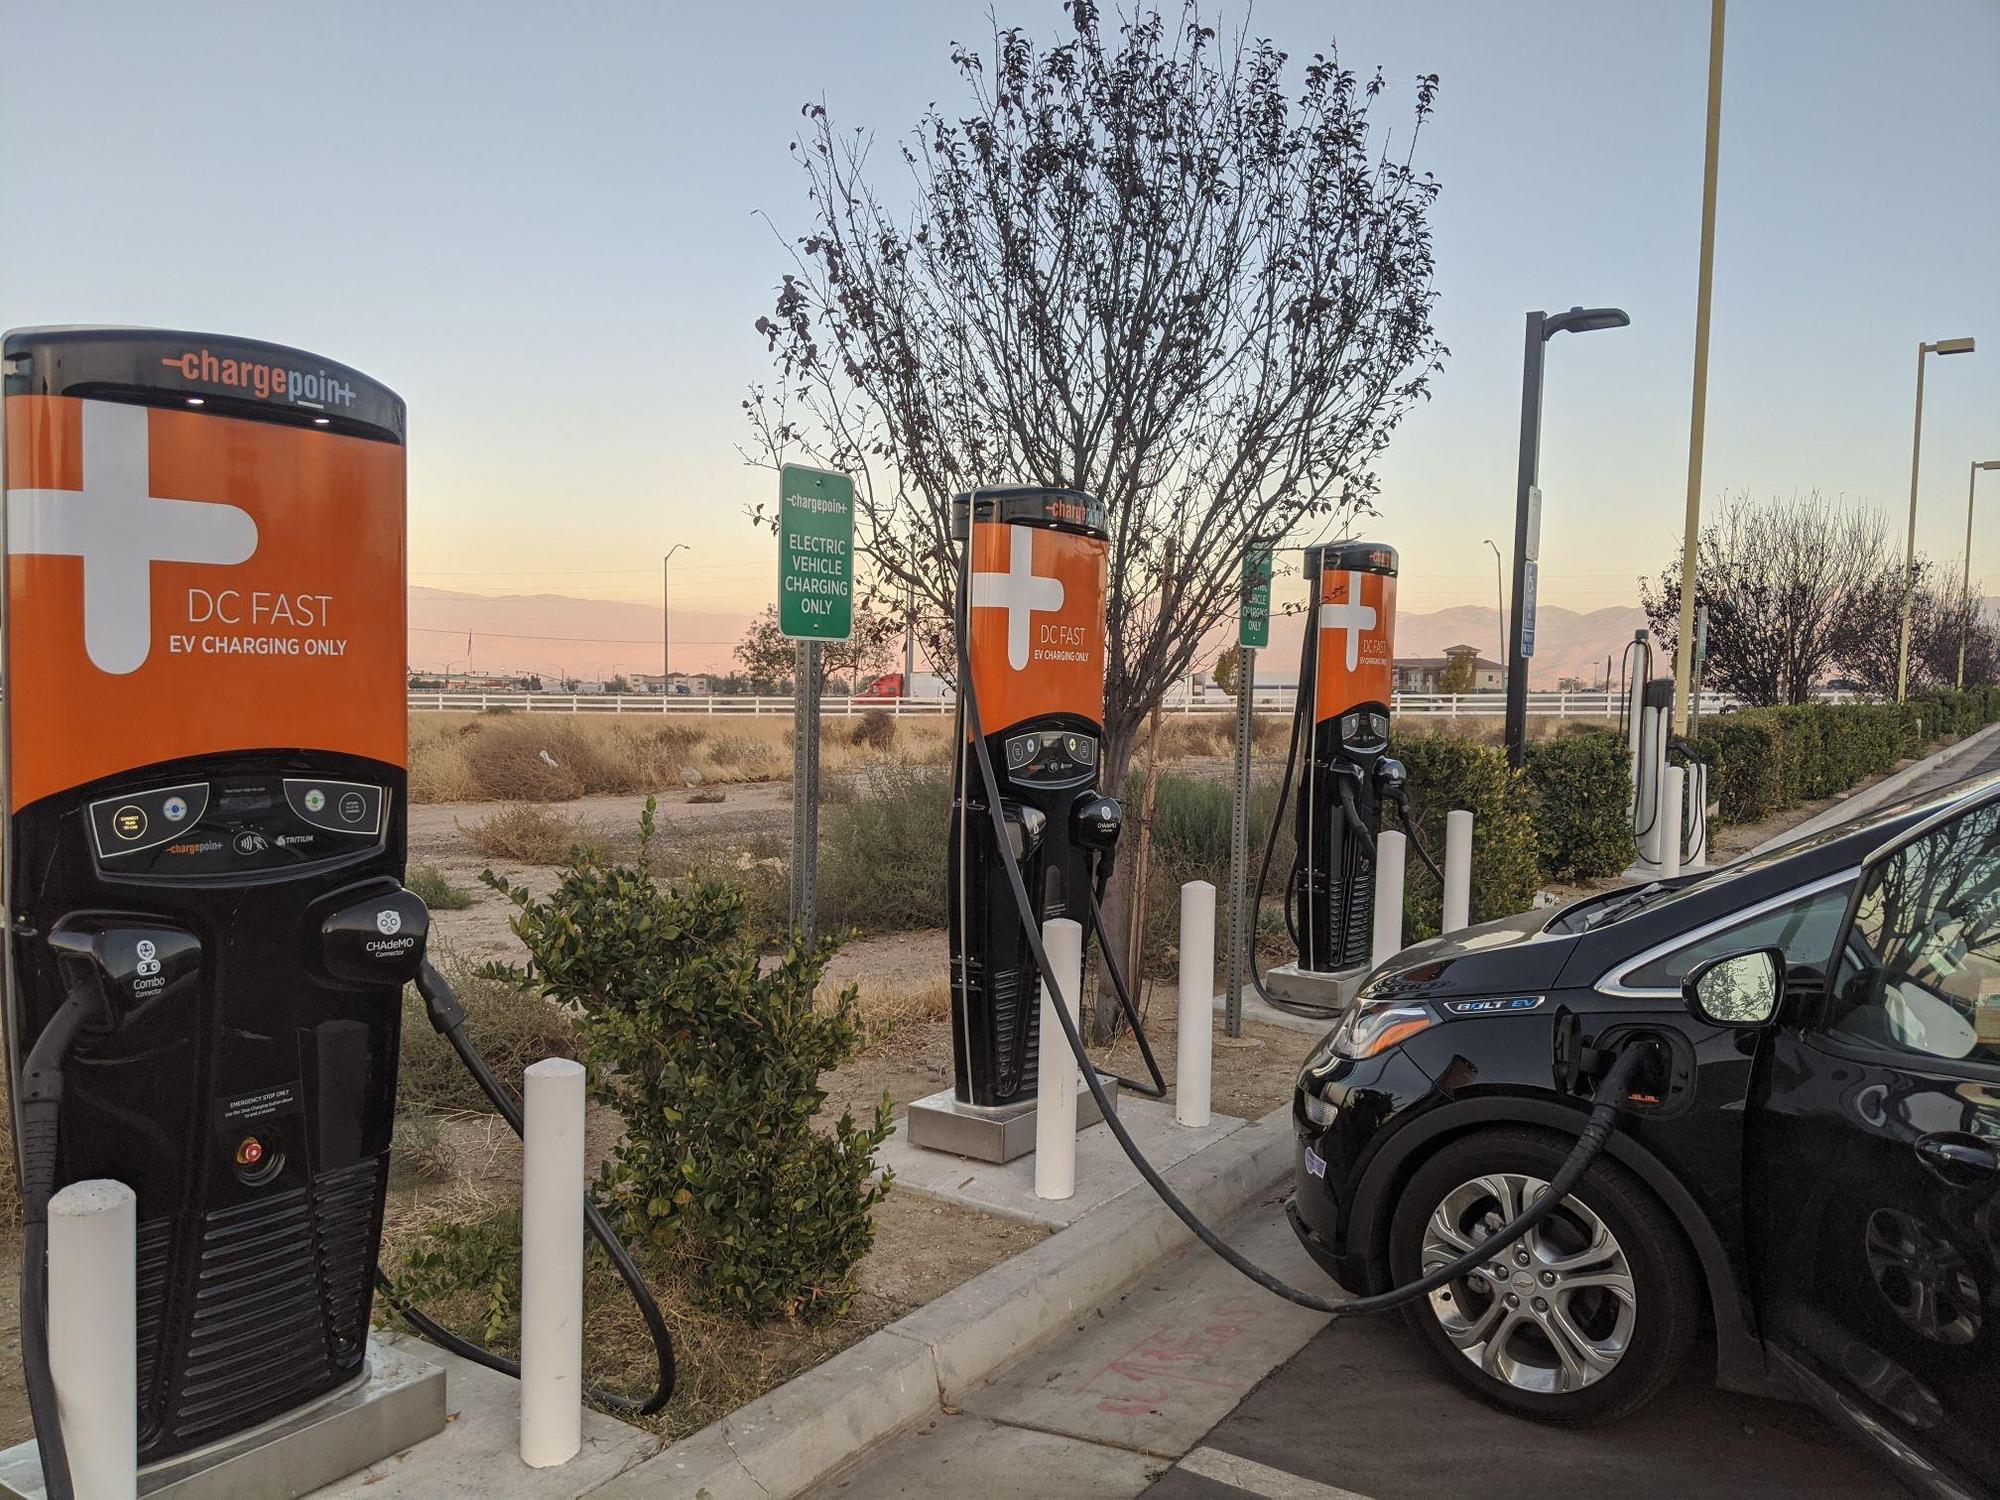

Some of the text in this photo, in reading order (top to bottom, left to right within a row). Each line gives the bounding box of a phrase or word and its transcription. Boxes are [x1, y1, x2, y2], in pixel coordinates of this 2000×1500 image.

[162, 349, 356, 408] chargepoint
[786, 493, 848, 514] chargepoint
[789, 533, 846, 555] ELECTRIC
[792, 555, 842, 575] VEHICLE
[785, 575, 848, 596] CHARGING
[189, 588, 333, 627] DC FAST
[801, 598, 833, 615] ONLY
[1247, 619, 1262, 631] ONLY
[1041, 624, 1086, 646] DC FAST
[169, 635, 347, 656] EV CHARGING ONLY
[1034, 649, 1089, 662] EV CHARGING ONLY
[285, 835, 313, 844] TRITIUM
[366, 937, 414, 951] CHAdeMO
[375, 949, 405, 958] Connector
[133, 976, 166, 990] Combo
[135, 988, 162, 998] Connector
[1456, 999, 1537, 1011] BOLT EV
[230, 1089, 290, 1109] EMERGENCY STOP ONLY
